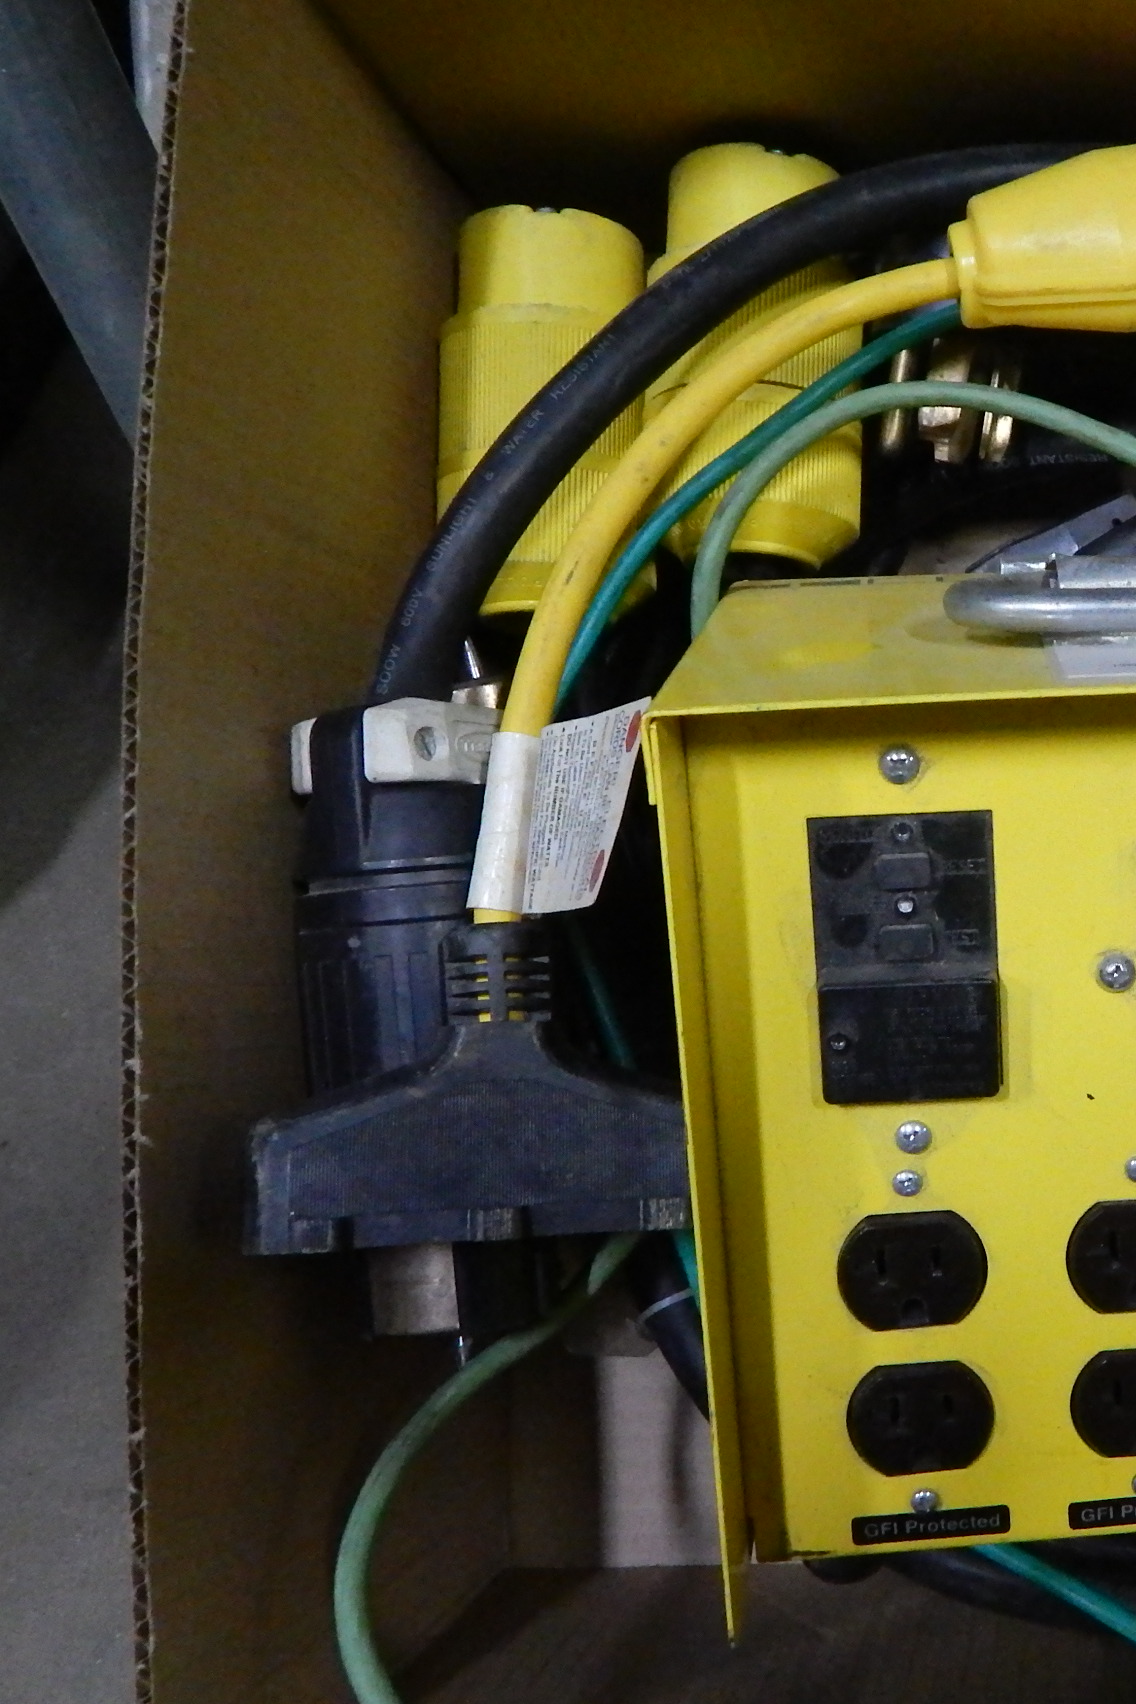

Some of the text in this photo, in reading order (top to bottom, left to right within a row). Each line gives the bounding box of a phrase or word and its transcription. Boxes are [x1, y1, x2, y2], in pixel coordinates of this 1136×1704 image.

[1081, 1506, 1113, 1522] GFI
[864, 1513, 1000, 1539] GFI Protected
